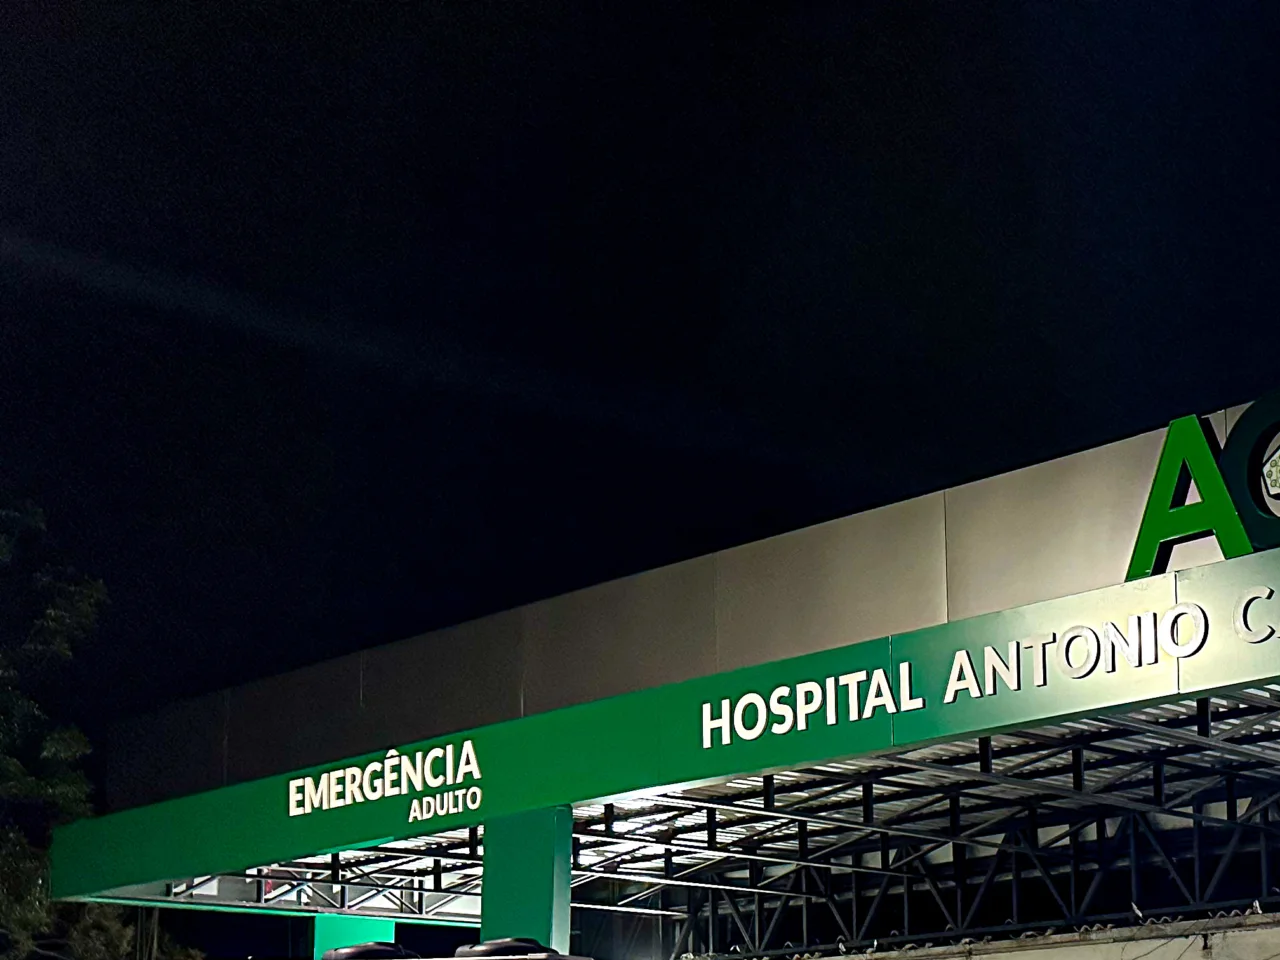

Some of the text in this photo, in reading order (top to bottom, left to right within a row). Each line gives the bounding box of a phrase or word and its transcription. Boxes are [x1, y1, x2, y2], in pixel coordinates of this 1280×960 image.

[702, 659, 923, 750] HOSPITAL
[943, 602, 1209, 704] ANTONIO
[289, 740, 482, 817] EMERGÊNCIA
[408, 786, 483, 823] ADULTO
